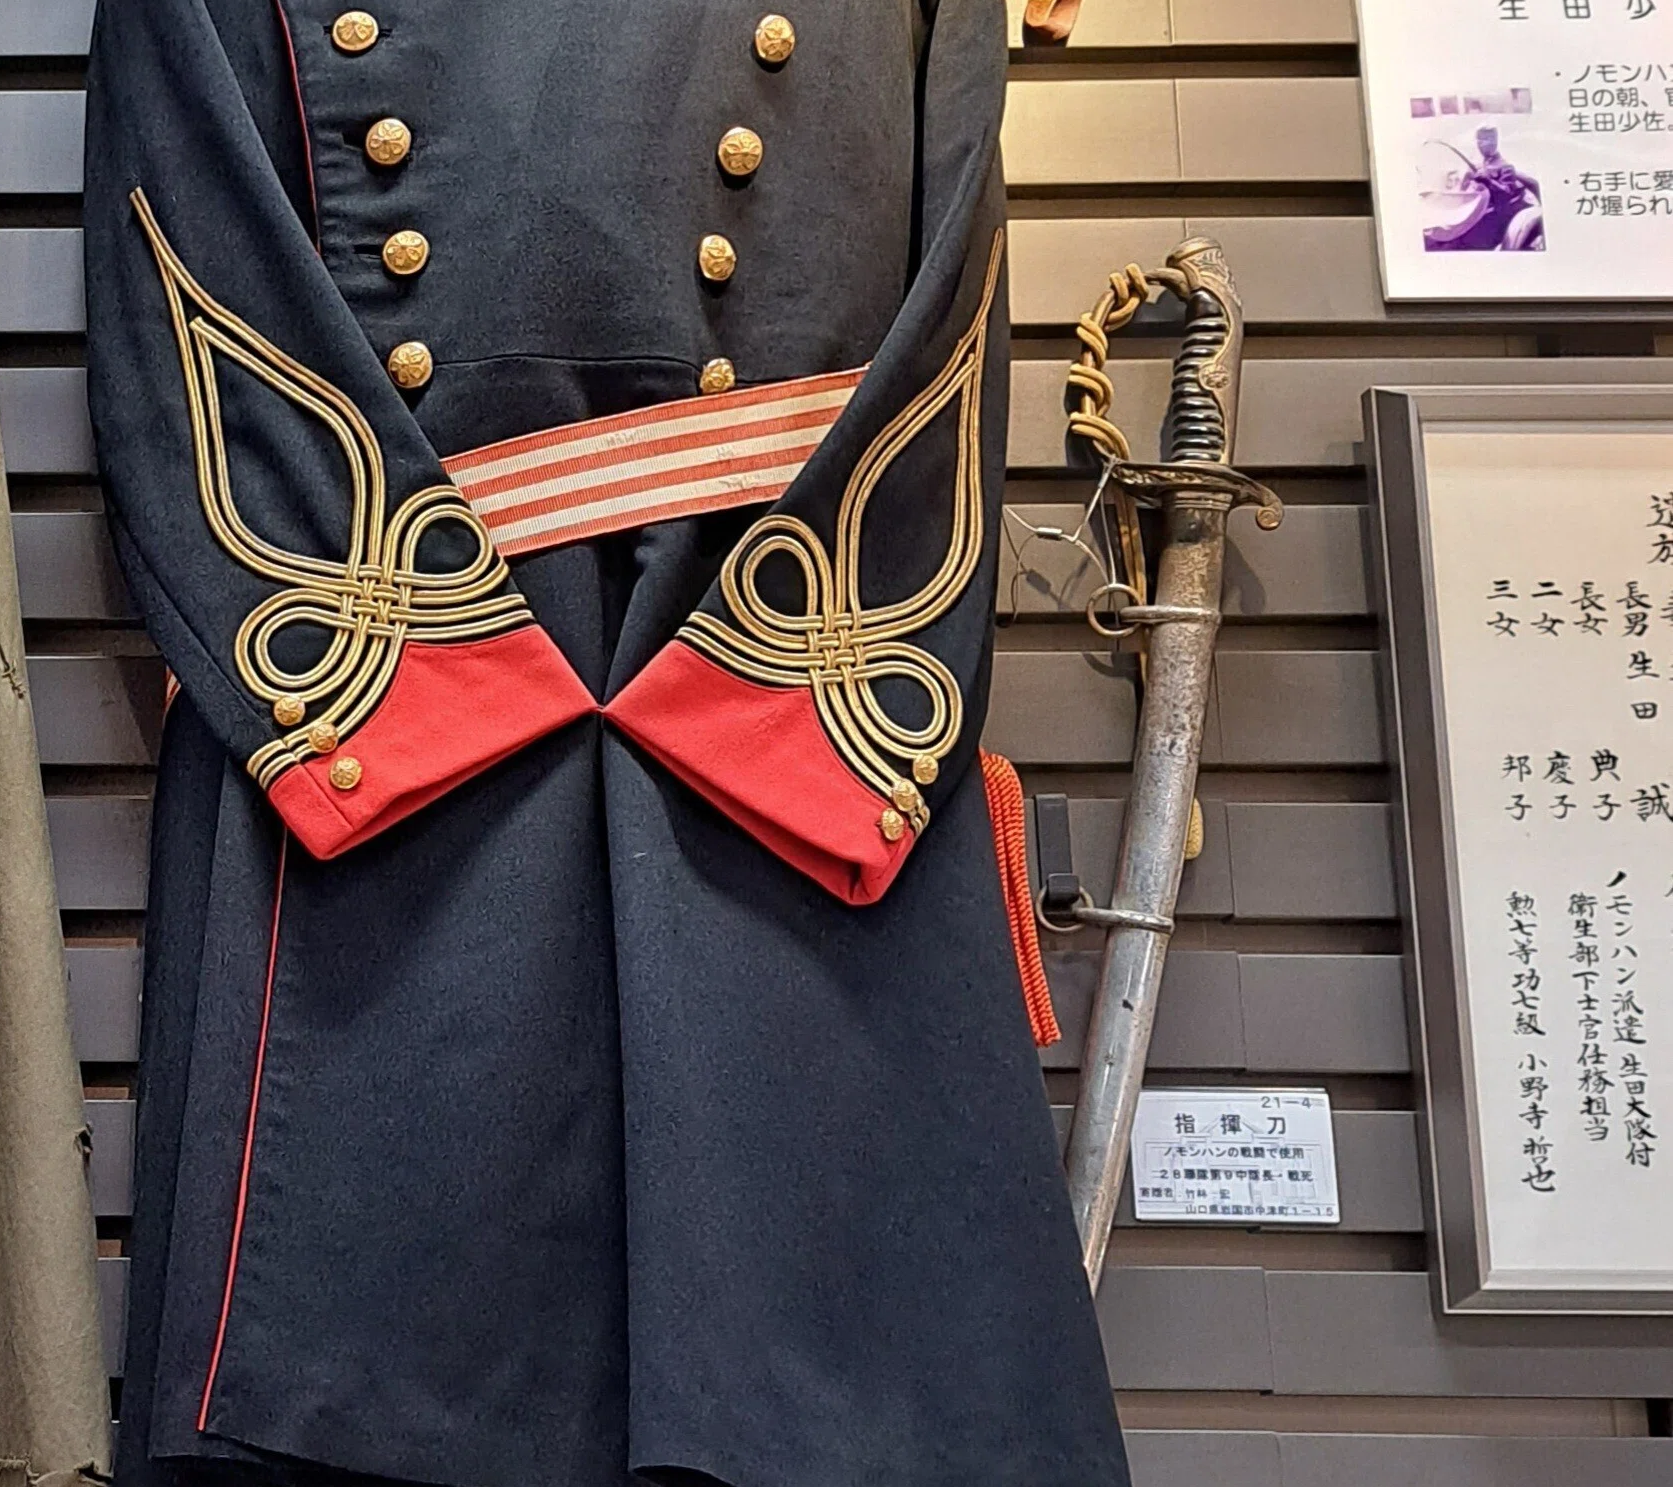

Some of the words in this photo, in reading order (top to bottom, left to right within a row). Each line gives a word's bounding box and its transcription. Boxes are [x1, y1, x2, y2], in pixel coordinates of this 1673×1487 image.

[1576, 195, 1673, 216] が握られ
[1486, 579, 1520, 637] 三女
[1530, 580, 1565, 637] 二女
[1571, 581, 1609, 636] 長女
[1615, 580, 1653, 636] 長男
[1589, 748, 1623, 822] 典子
[1175, 1113, 1287, 1135] 指揮刀
[1261, 1096, 1313, 1109] 21-4
